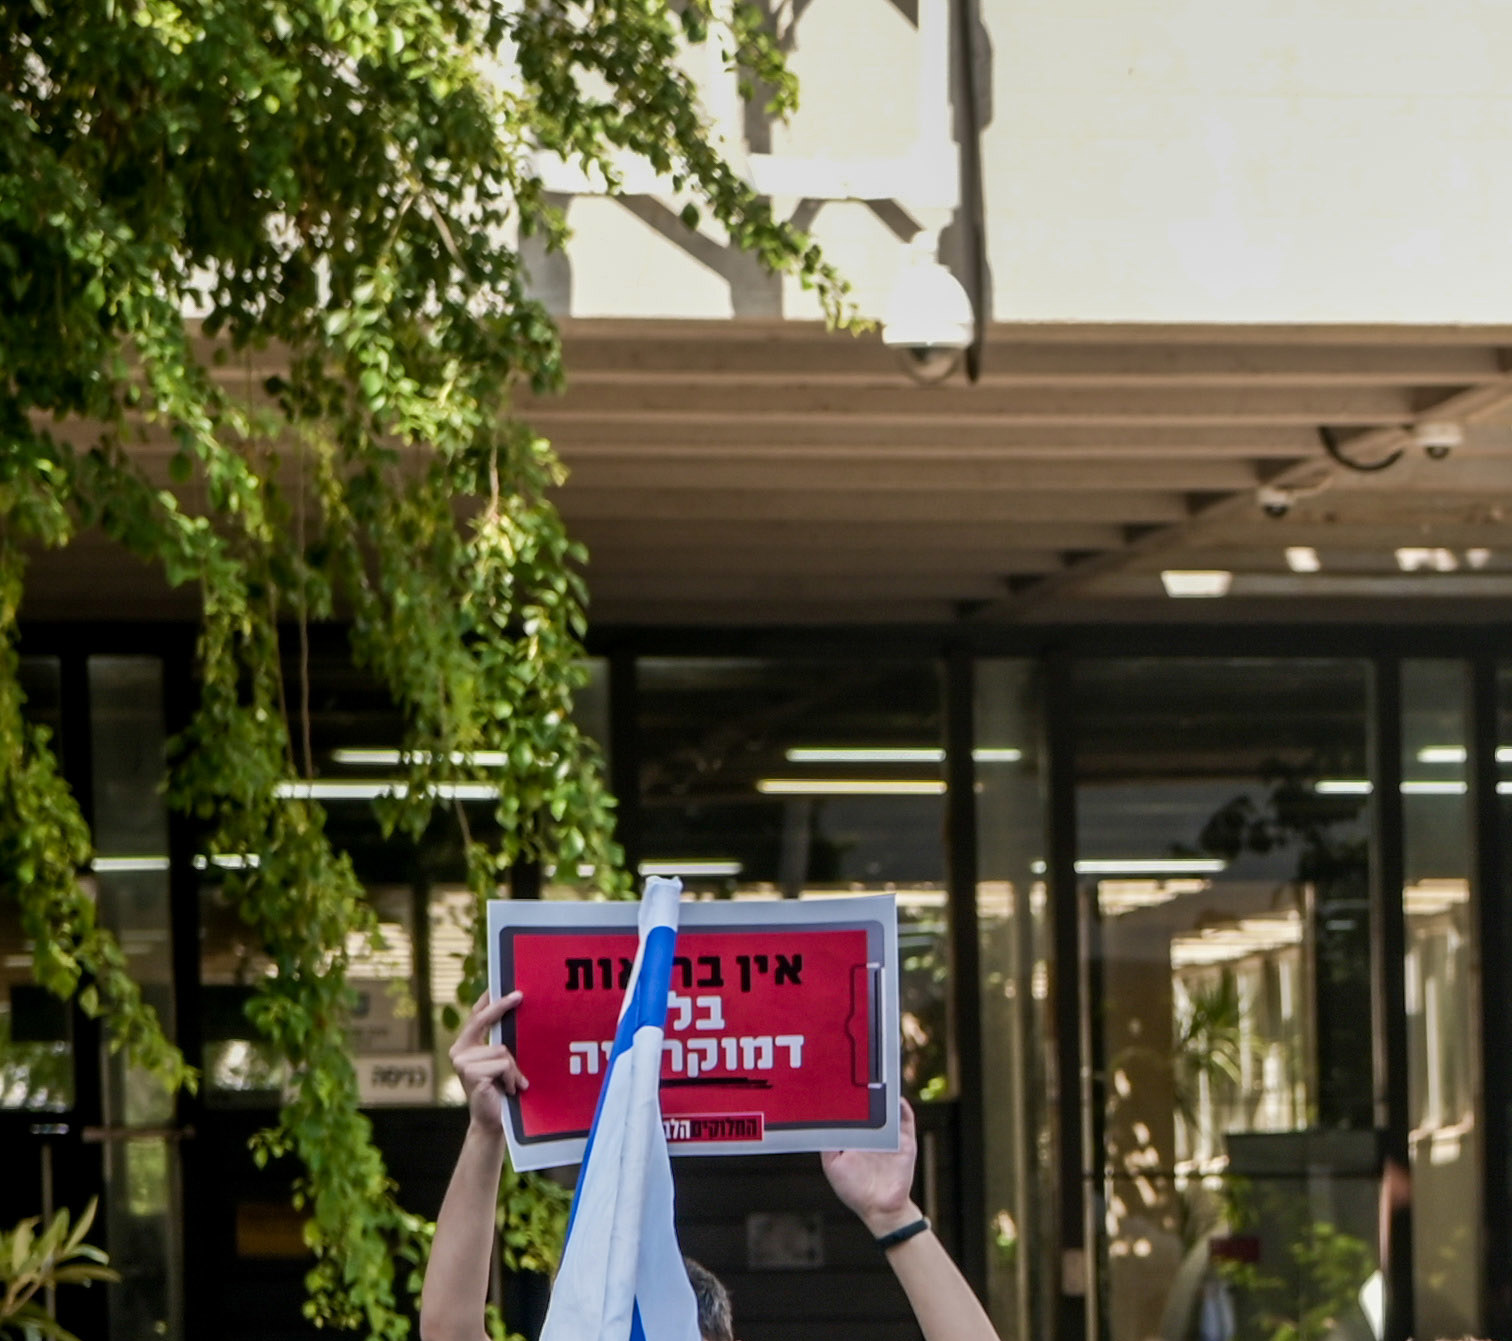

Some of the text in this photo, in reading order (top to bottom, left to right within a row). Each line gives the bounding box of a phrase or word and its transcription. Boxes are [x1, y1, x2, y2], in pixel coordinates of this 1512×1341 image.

[565, 954, 803, 992] אין ברות
[667, 991, 726, 1031] בל
[569, 1035, 805, 1078] דמוקריה
